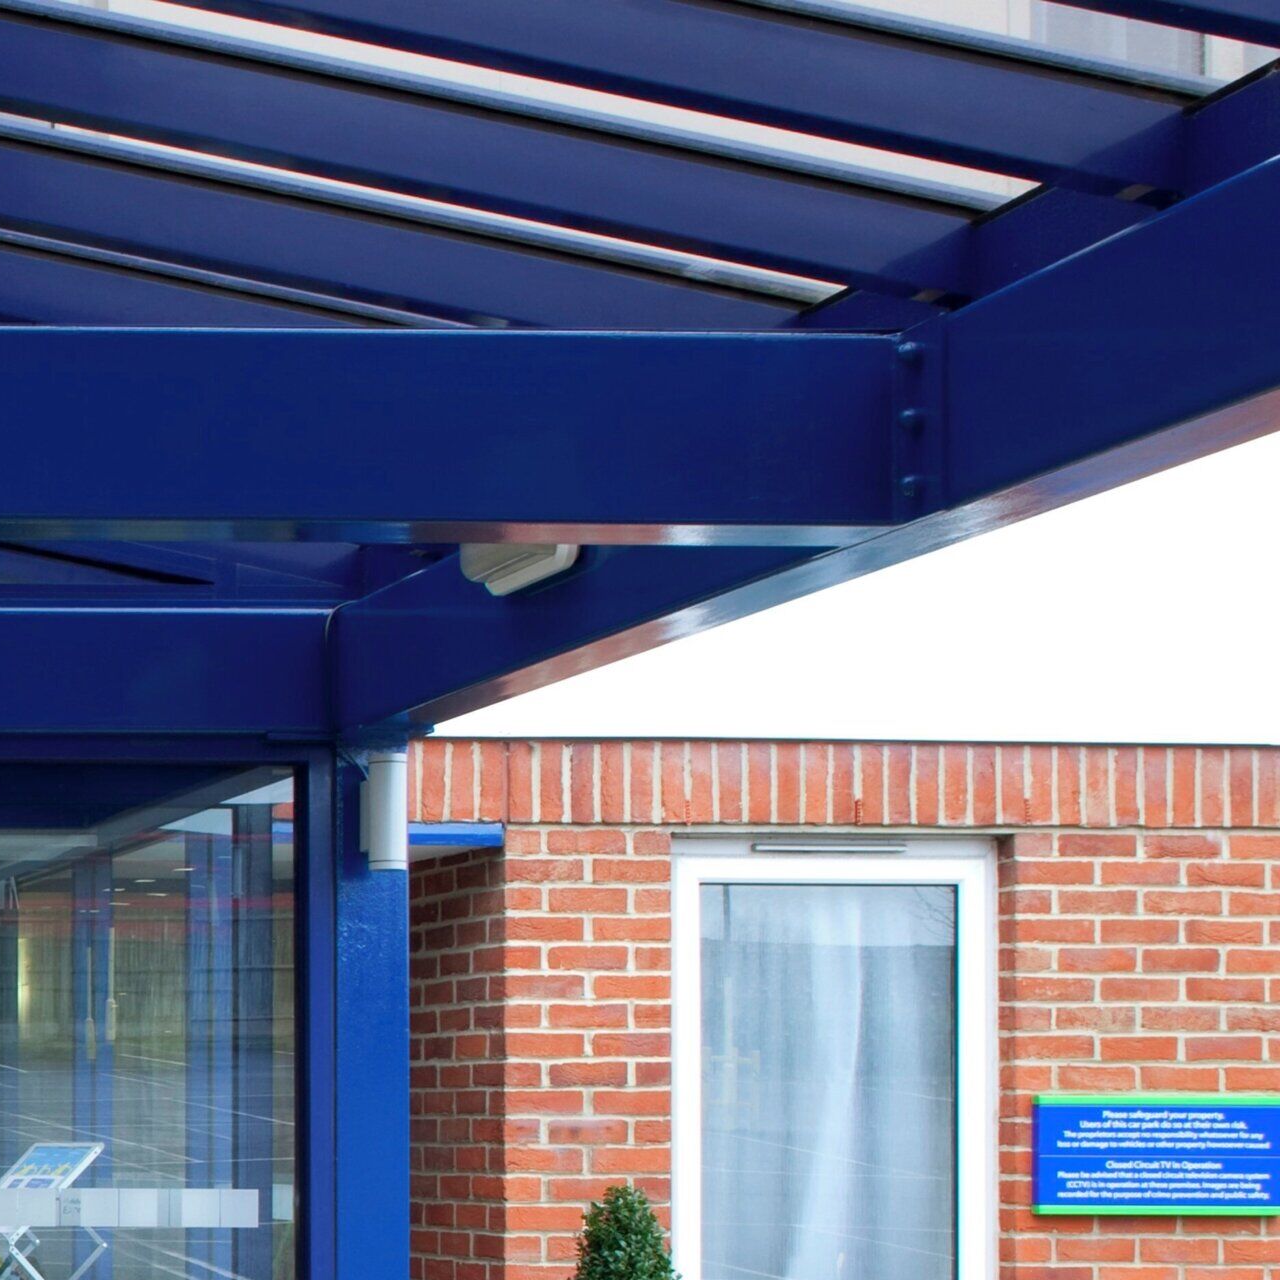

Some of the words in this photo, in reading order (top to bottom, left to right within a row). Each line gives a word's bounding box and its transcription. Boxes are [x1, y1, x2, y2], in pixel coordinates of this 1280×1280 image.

[1102, 1110, 1128, 1119] Please
[1128, 1110, 1168, 1121] safeguard
[1079, 1120, 1102, 1129] Users
[1105, 1161, 1133, 1169] Closed
[1133, 1161, 1160, 1169] Circuit
[1160, 1161, 1171, 1169] TV
